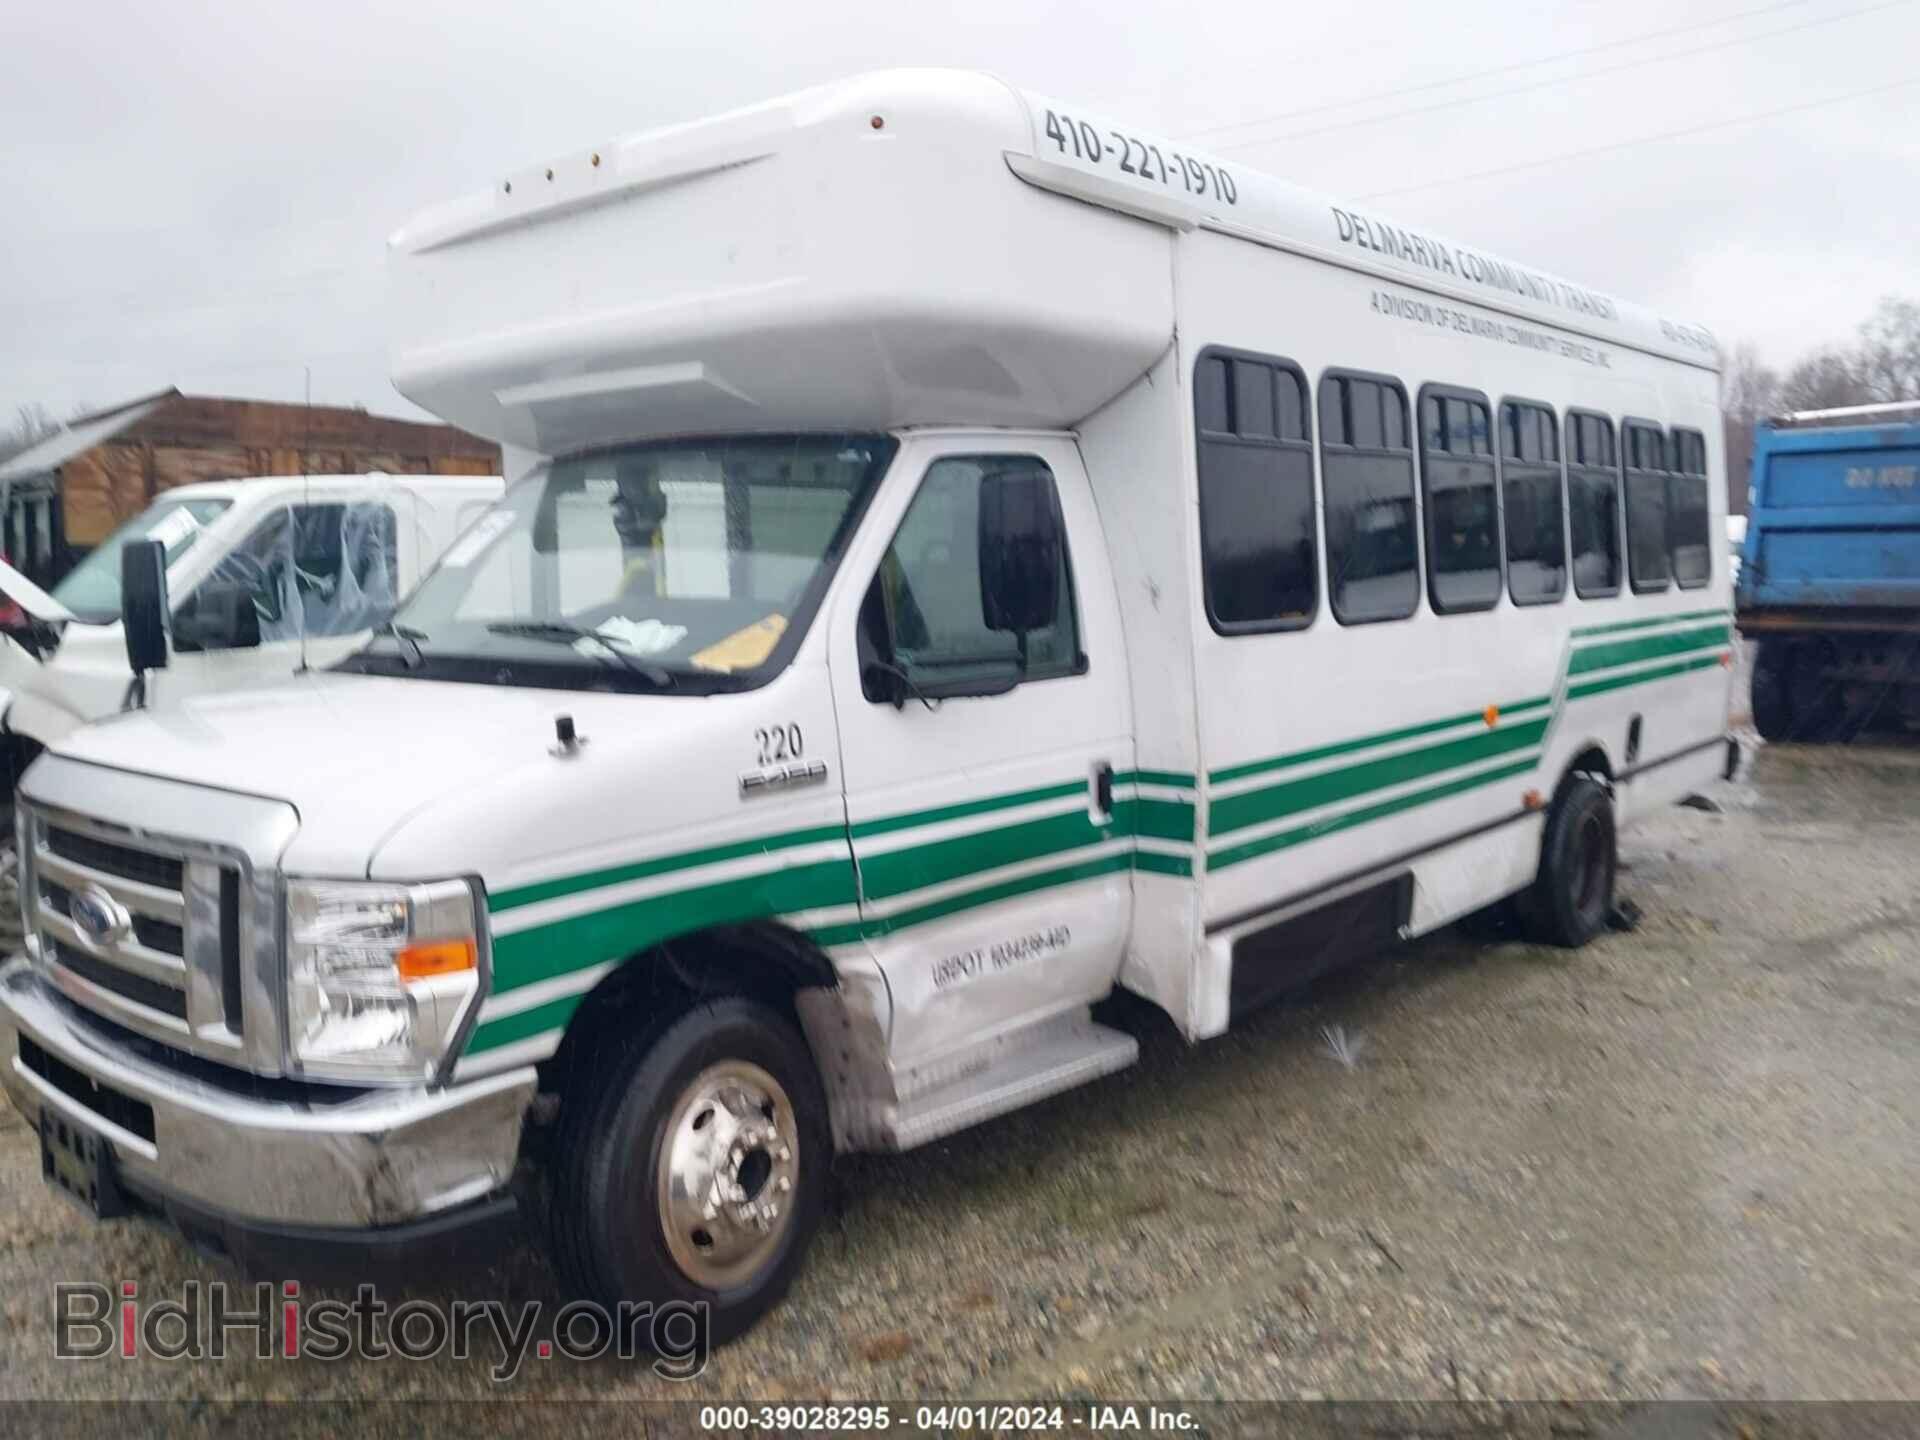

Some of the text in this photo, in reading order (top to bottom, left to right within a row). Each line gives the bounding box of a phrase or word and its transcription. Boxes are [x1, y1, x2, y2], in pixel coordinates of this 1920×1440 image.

[1046, 109, 1237, 205] 410-221-1910
[1331, 206, 1456, 276] DELMARVA
[754, 722, 803, 767] 220
